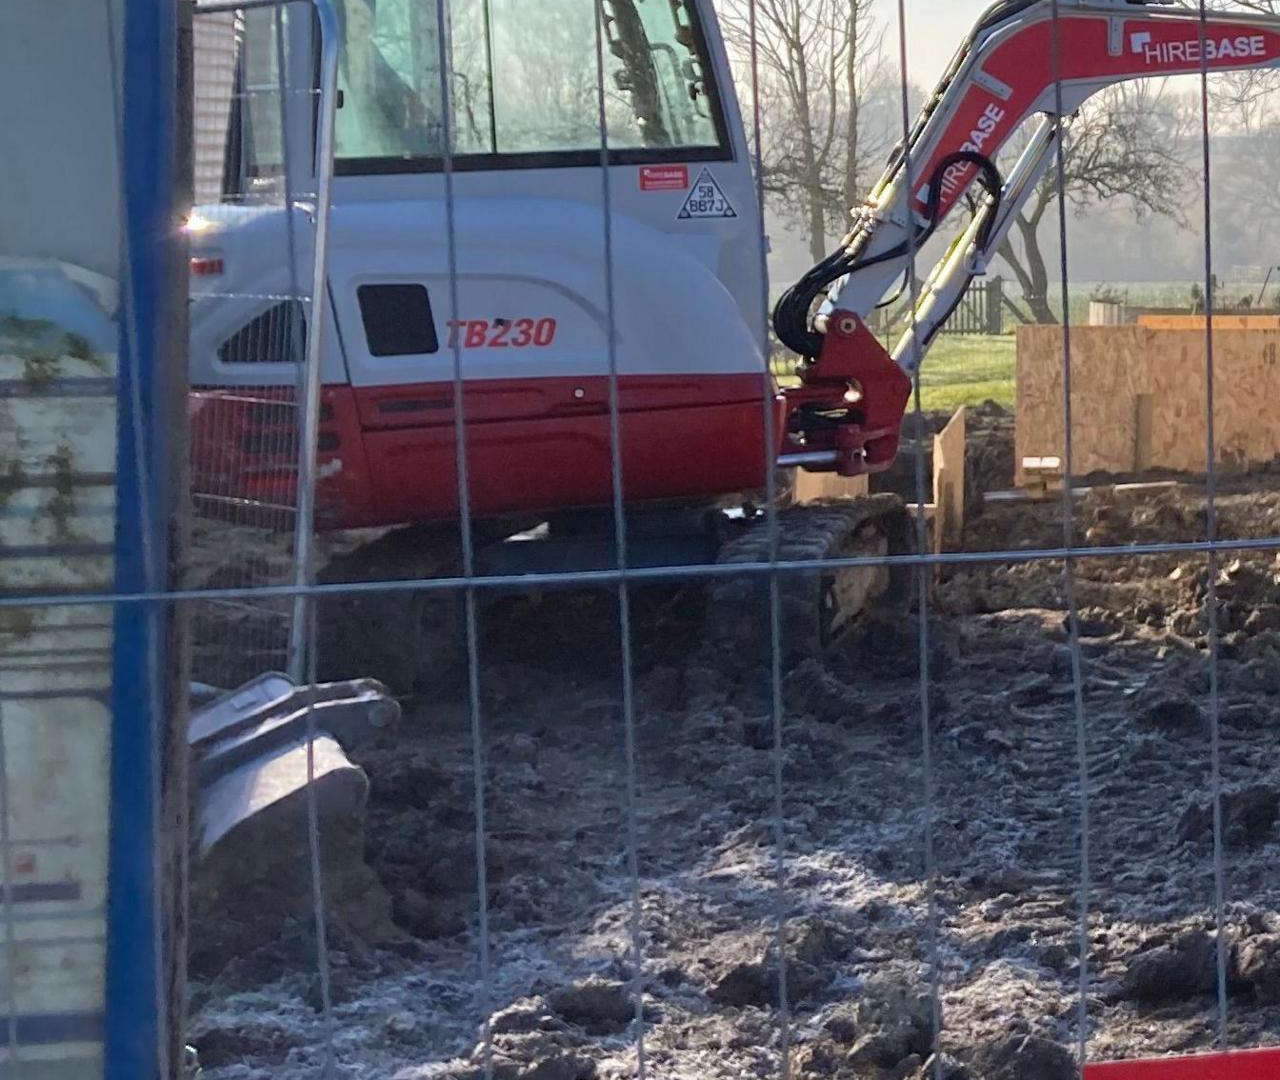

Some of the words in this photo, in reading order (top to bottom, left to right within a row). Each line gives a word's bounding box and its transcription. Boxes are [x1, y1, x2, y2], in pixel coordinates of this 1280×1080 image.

[1144, 35, 1267, 65] HIREBASE
[698, 185, 714, 199] 58
[446, 318, 557, 349] TB230
